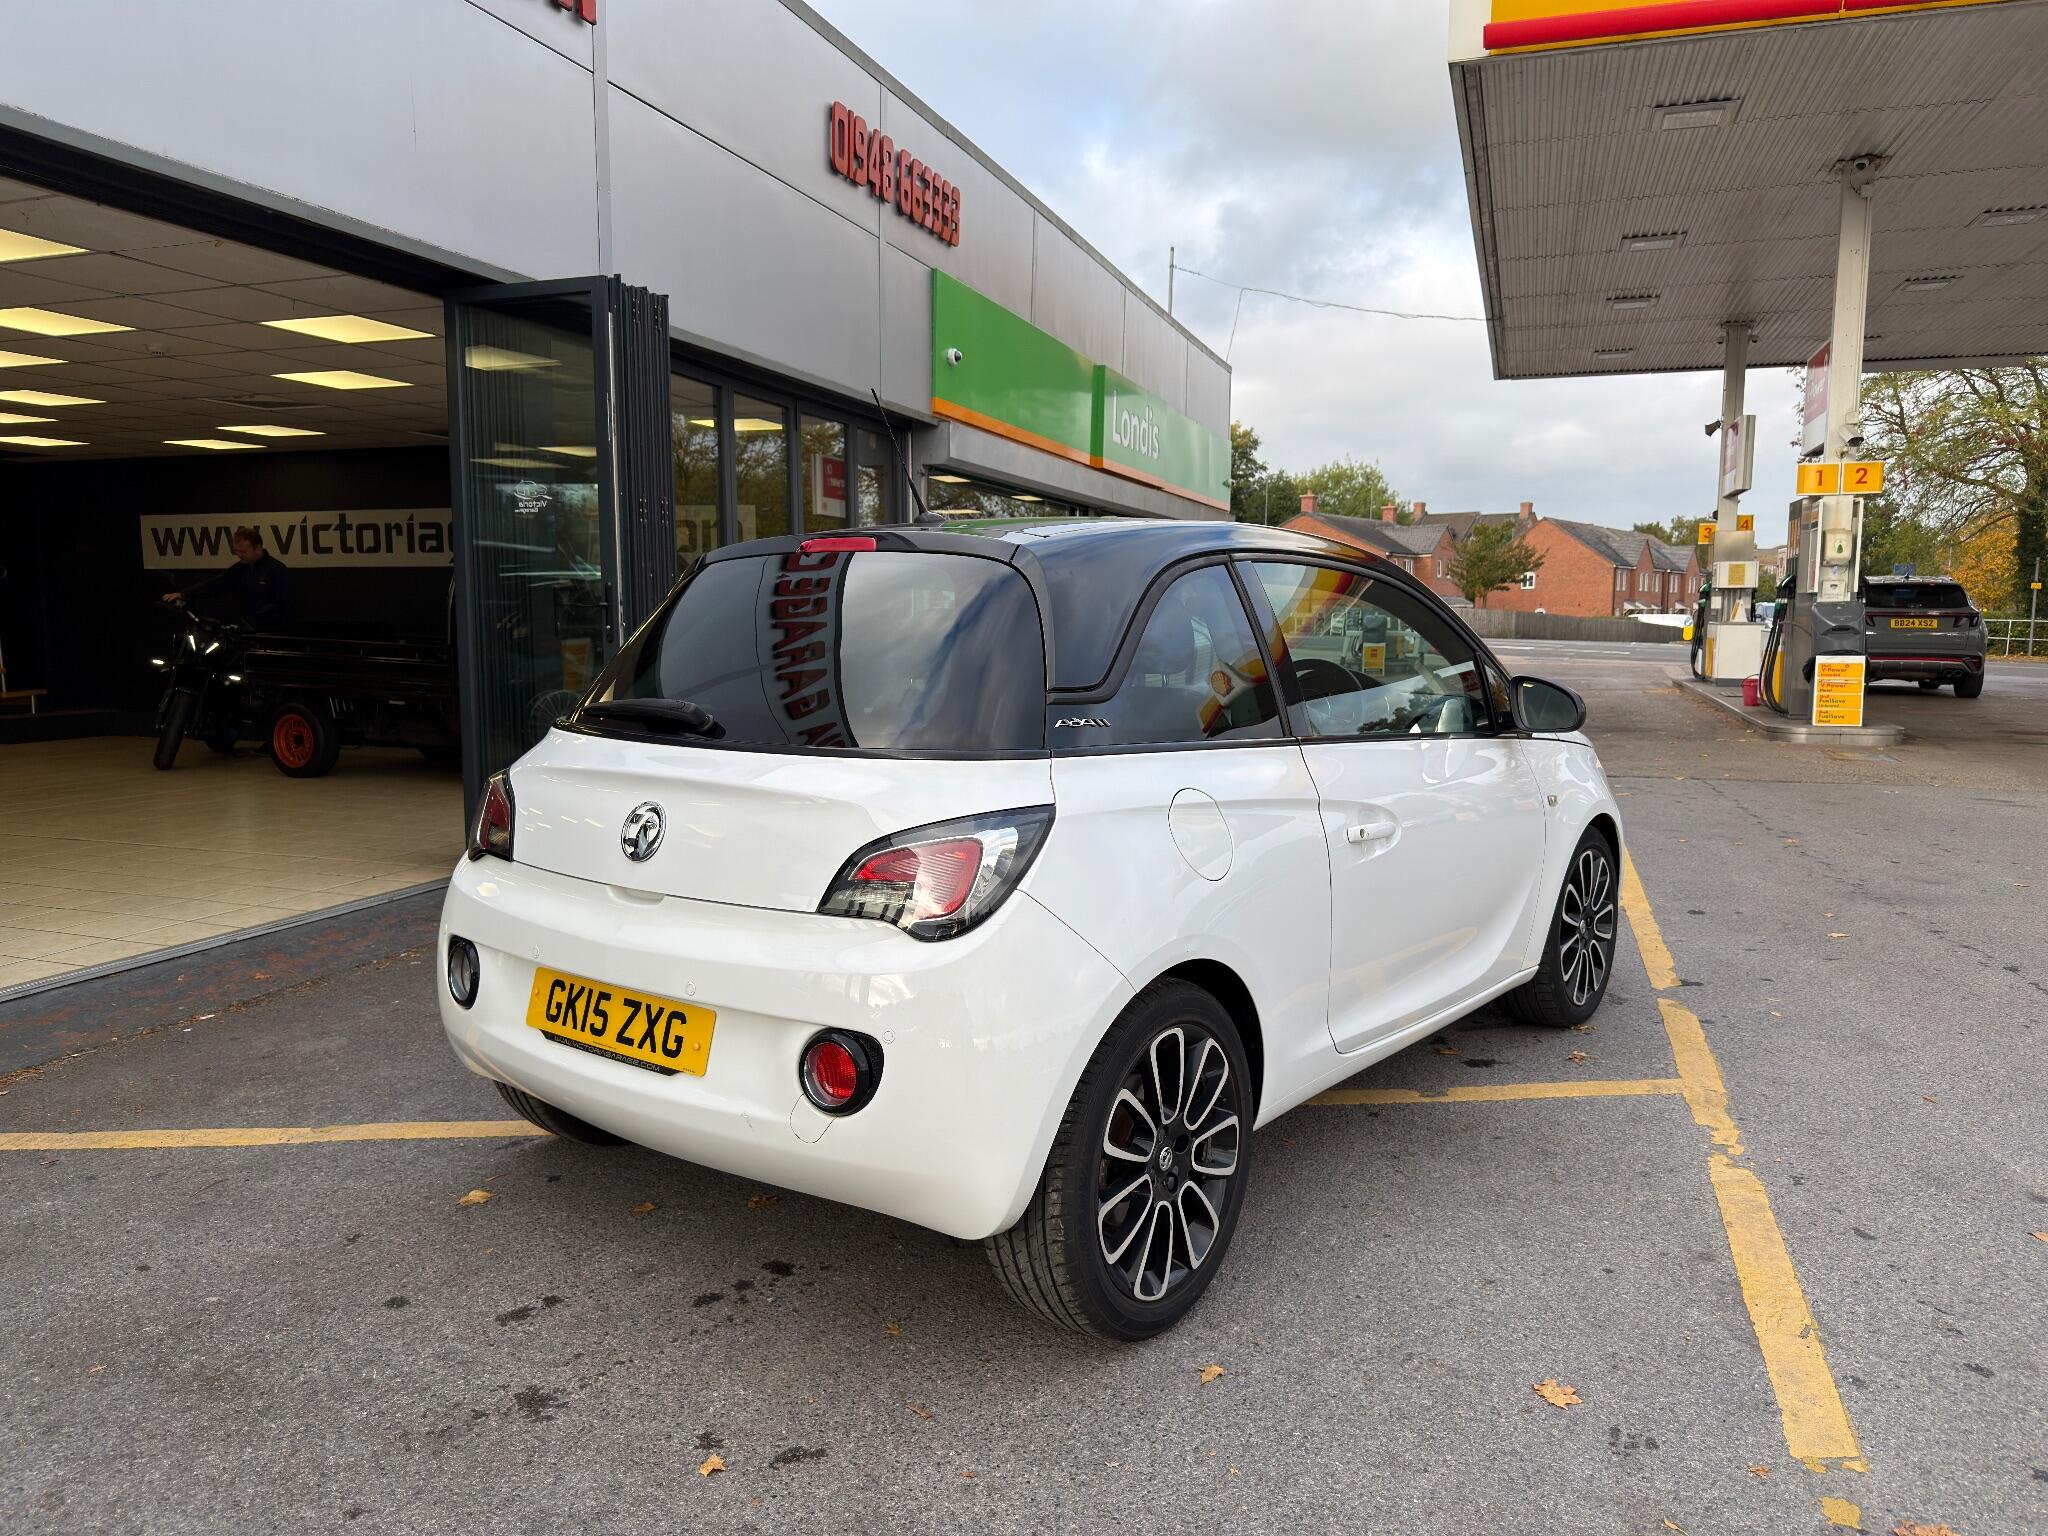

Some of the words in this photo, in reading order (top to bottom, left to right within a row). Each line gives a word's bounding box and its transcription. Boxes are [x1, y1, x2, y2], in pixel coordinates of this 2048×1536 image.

[831, 101, 894, 204] 01948
[898, 148, 961, 248] 663333
[1112, 389, 1160, 460] Londis
[1815, 469, 1823, 486] 1
[1855, 467, 1868, 485] 2
[1703, 526, 1712, 538] 3
[1740, 519, 1750, 531] 4
[545, 978, 612, 1038] GK15
[615, 997, 688, 1059] ZXG
